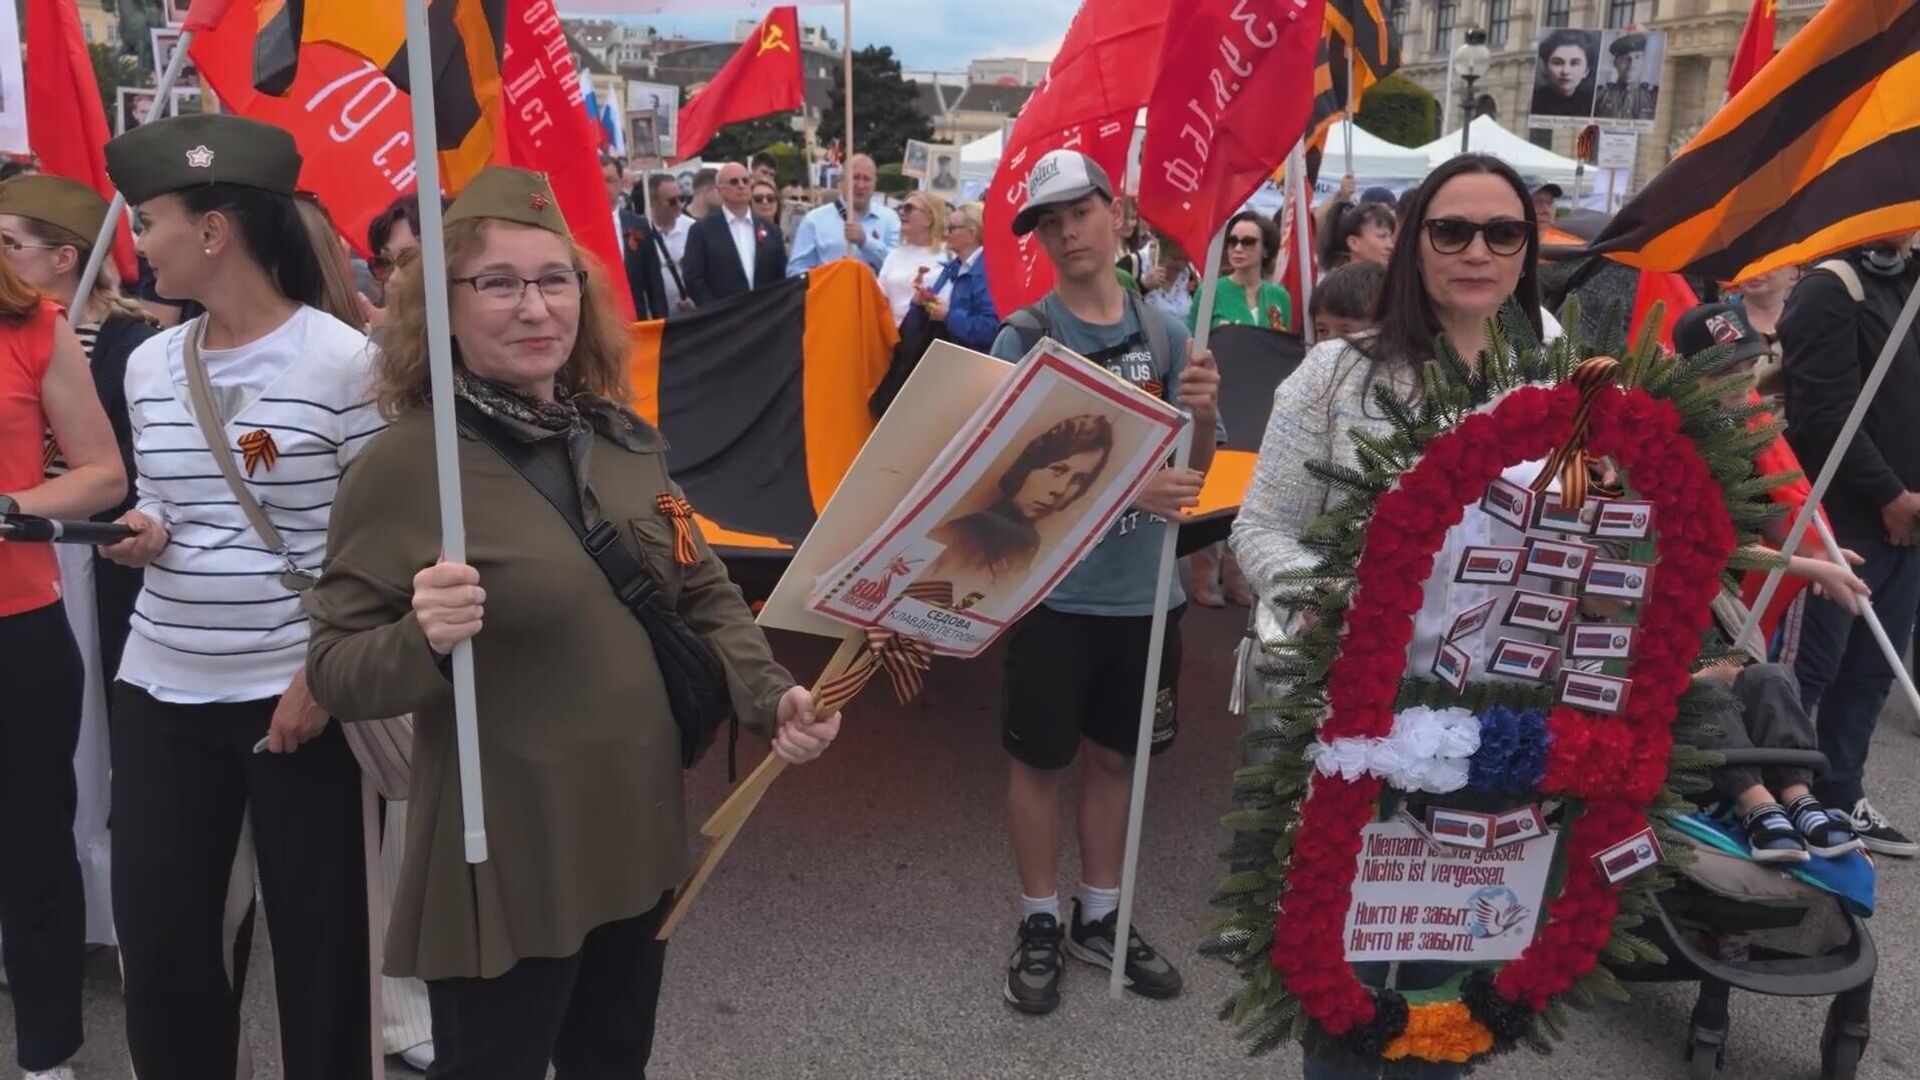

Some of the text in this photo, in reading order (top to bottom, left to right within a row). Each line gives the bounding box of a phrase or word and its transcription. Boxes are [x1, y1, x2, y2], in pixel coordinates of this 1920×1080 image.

[305, 60, 397, 142] 79
[1131, 364, 1151, 381] US
[926, 609, 972, 630] СЕДОВА
[1365, 834, 1424, 858] Niemann
[1361, 859, 1506, 888] Nichts ist vergessen.
[1354, 902, 1472, 927] Никто не забыт.
[1350, 929, 1474, 952] Ничто не забыто.
